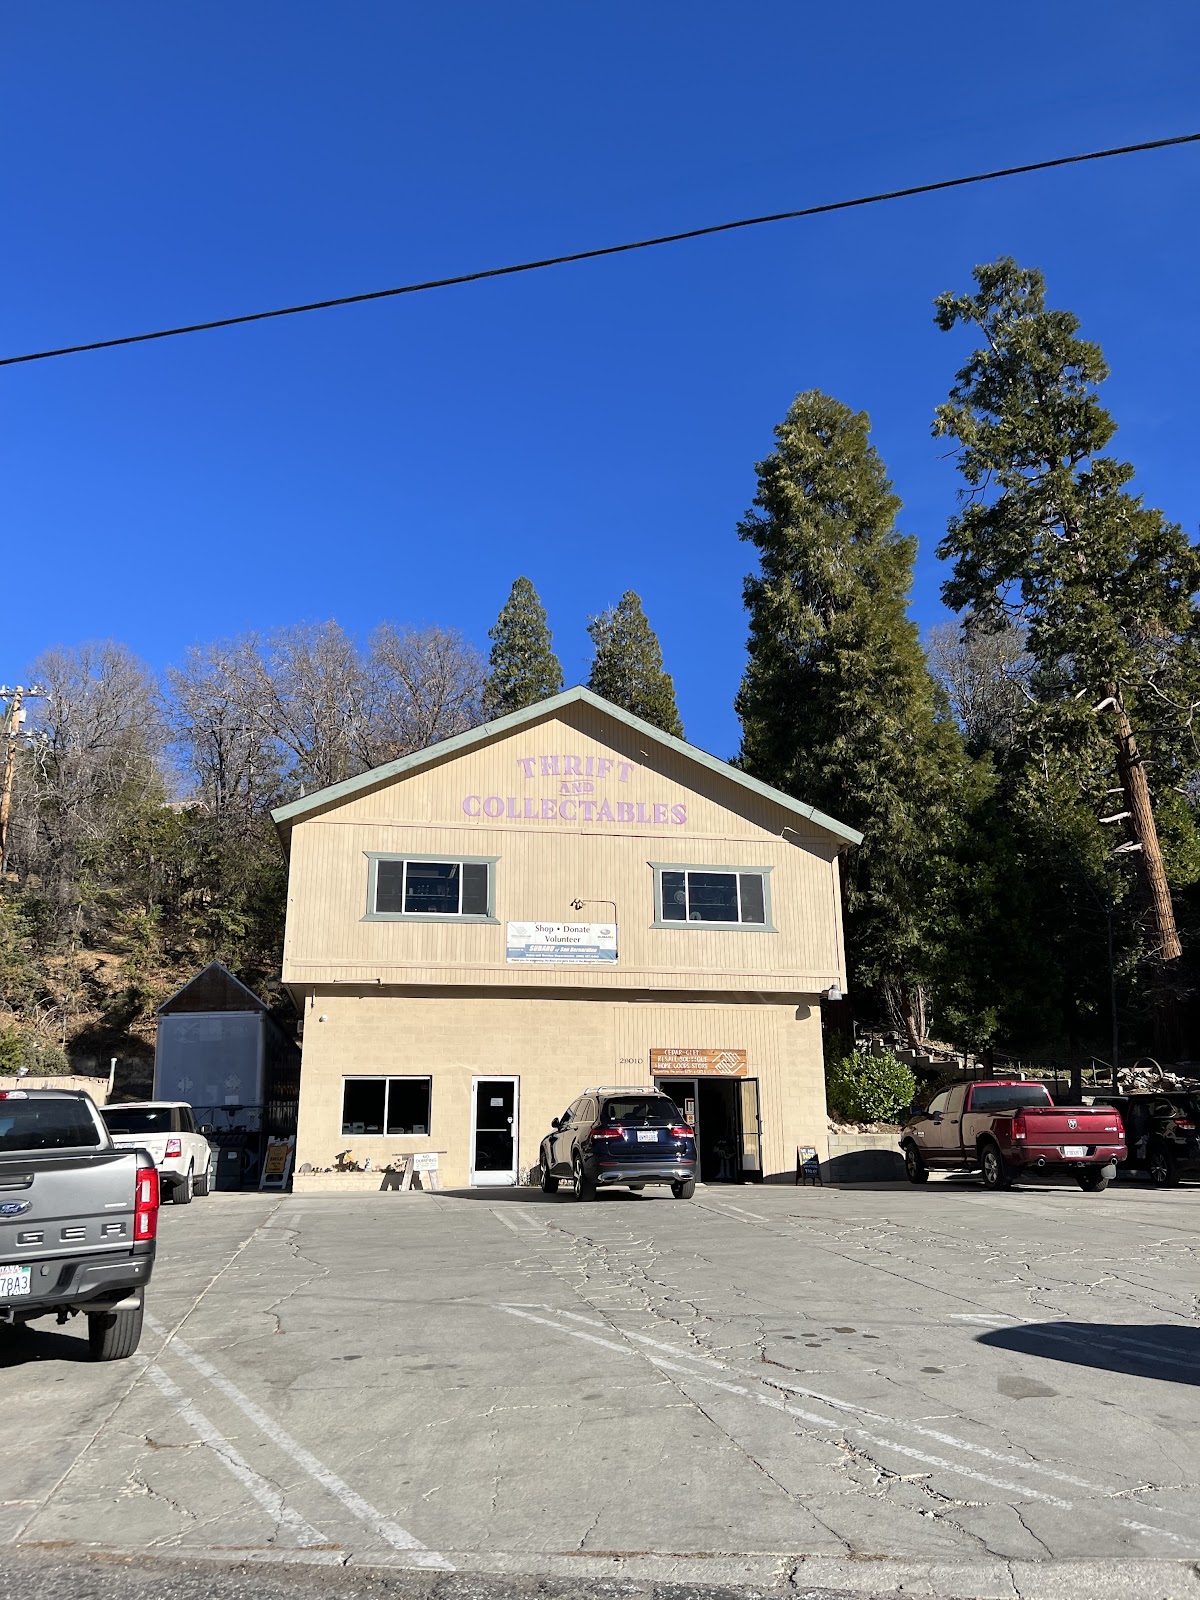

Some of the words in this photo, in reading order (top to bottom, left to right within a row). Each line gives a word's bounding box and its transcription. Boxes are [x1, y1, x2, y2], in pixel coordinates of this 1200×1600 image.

[517, 755, 635, 783] THRIFT
[559, 781, 595, 793] AND
[462, 795, 688, 825] COLLECTABLES
[535, 925, 554, 934] Shop
[545, 935, 581, 943] Volunteer
